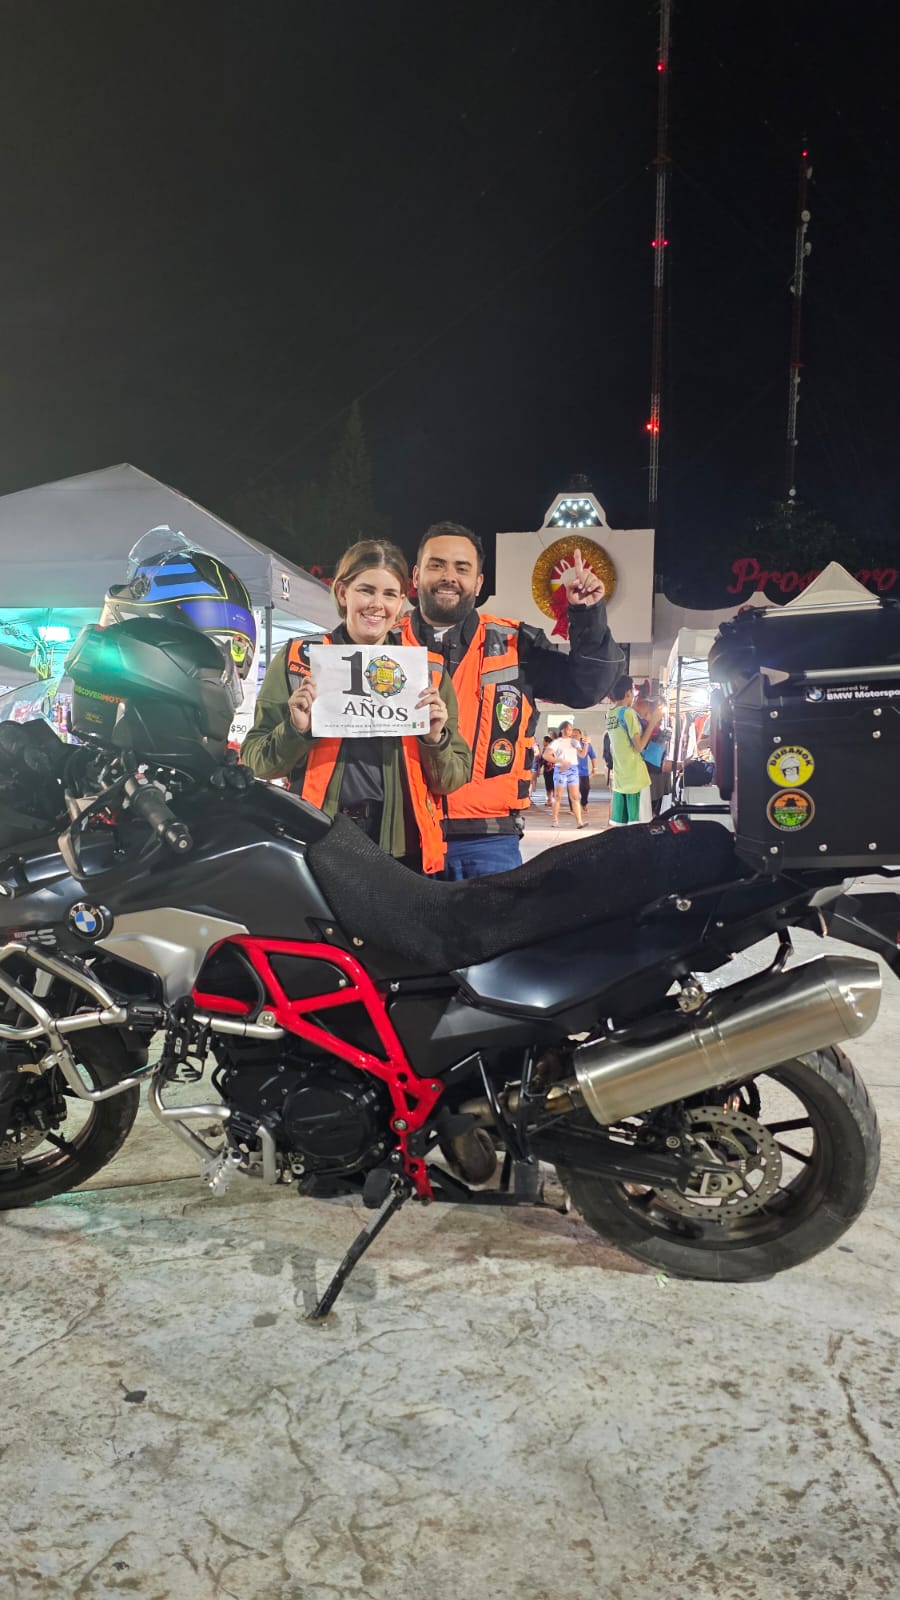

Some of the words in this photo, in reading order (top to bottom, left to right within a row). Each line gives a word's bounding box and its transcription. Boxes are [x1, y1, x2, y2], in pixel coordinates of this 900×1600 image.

[827, 692, 853, 701] BMW
[342, 698, 409, 721] AÑOS
[231, 724, 247, 734] $50
